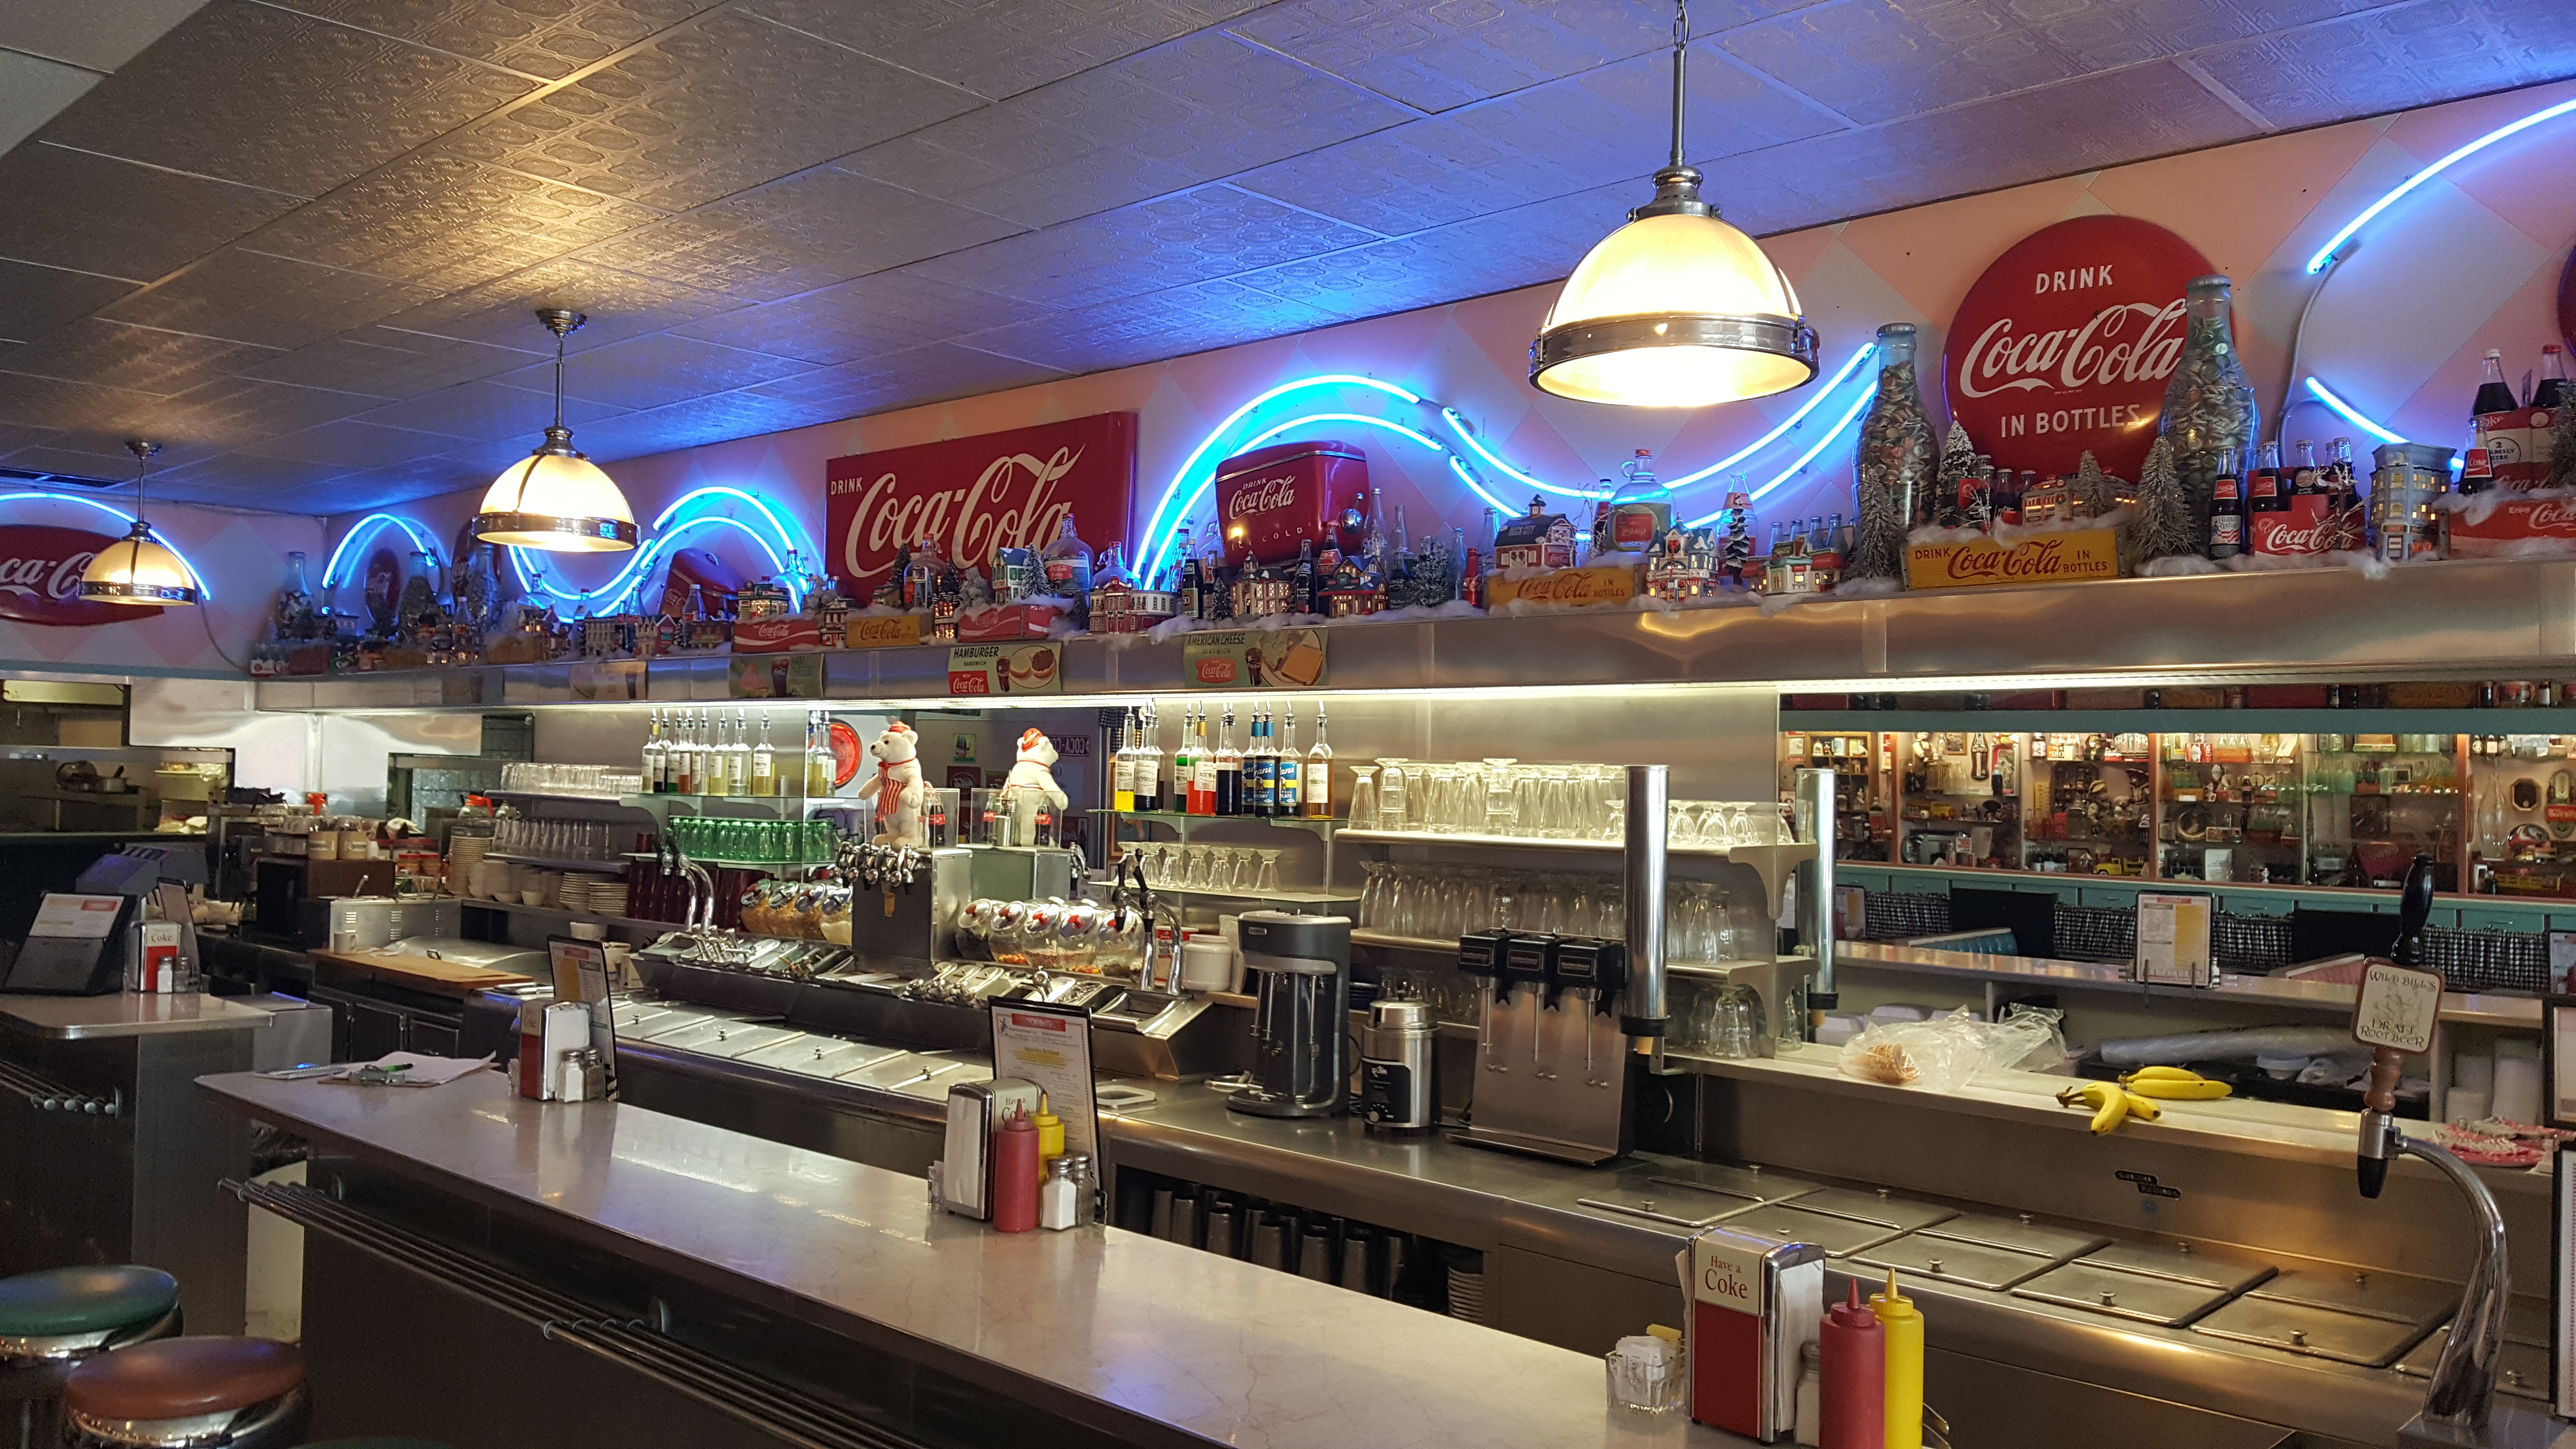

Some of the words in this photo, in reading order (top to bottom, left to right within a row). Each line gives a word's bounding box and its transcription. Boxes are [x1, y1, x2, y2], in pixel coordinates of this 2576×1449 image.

[2035, 264, 2113, 295] DRINK
[1960, 298, 2188, 398] Coca-Cola
[2001, 414, 2025, 438] IN
[2036, 403, 2141, 435] BOTTLES
[831, 477, 863, 495] DRINK
[1242, 477, 1268, 490] DRINK
[1229, 475, 1296, 520] Coca-Cola
[845, 443, 1086, 578] Coca-Cola
[1262, 527, 1303, 542] COLD
[2267, 522, 2356, 551] Coca-Coa
[1915, 547, 1951, 560] DRINK
[1947, 539, 2064, 580] Coca-Cola
[2077, 549, 2090, 561] IN
[2063, 562, 2108, 573] BOTTLES
[1517, 572, 1594, 599] Coca-Cola
[1594, 589, 1625, 597] BOTTLES
[860, 618, 901, 641] Coca-Cola
[1188, 633, 1220, 646] AMERICAN
[1220, 632, 1245, 645] CHEESE
[953, 646, 999, 659] HAMBURGER
[1201, 663, 1231, 678] Coca-Cola
[953, 677, 985, 693] Coca-Cola
[2370, 970, 2399, 982] WILD
[2361, 1025, 2389, 1039] ROOT
[2372, 1018, 2418, 1035] DRAFT
[1005, 1097, 1017, 1106] Hav
[1002, 1107, 1029, 1122] Coe
[1710, 1255, 1733, 1272] Have
[1736, 1264, 1742, 1274] a
[1705, 1269, 1748, 1299] Coke
